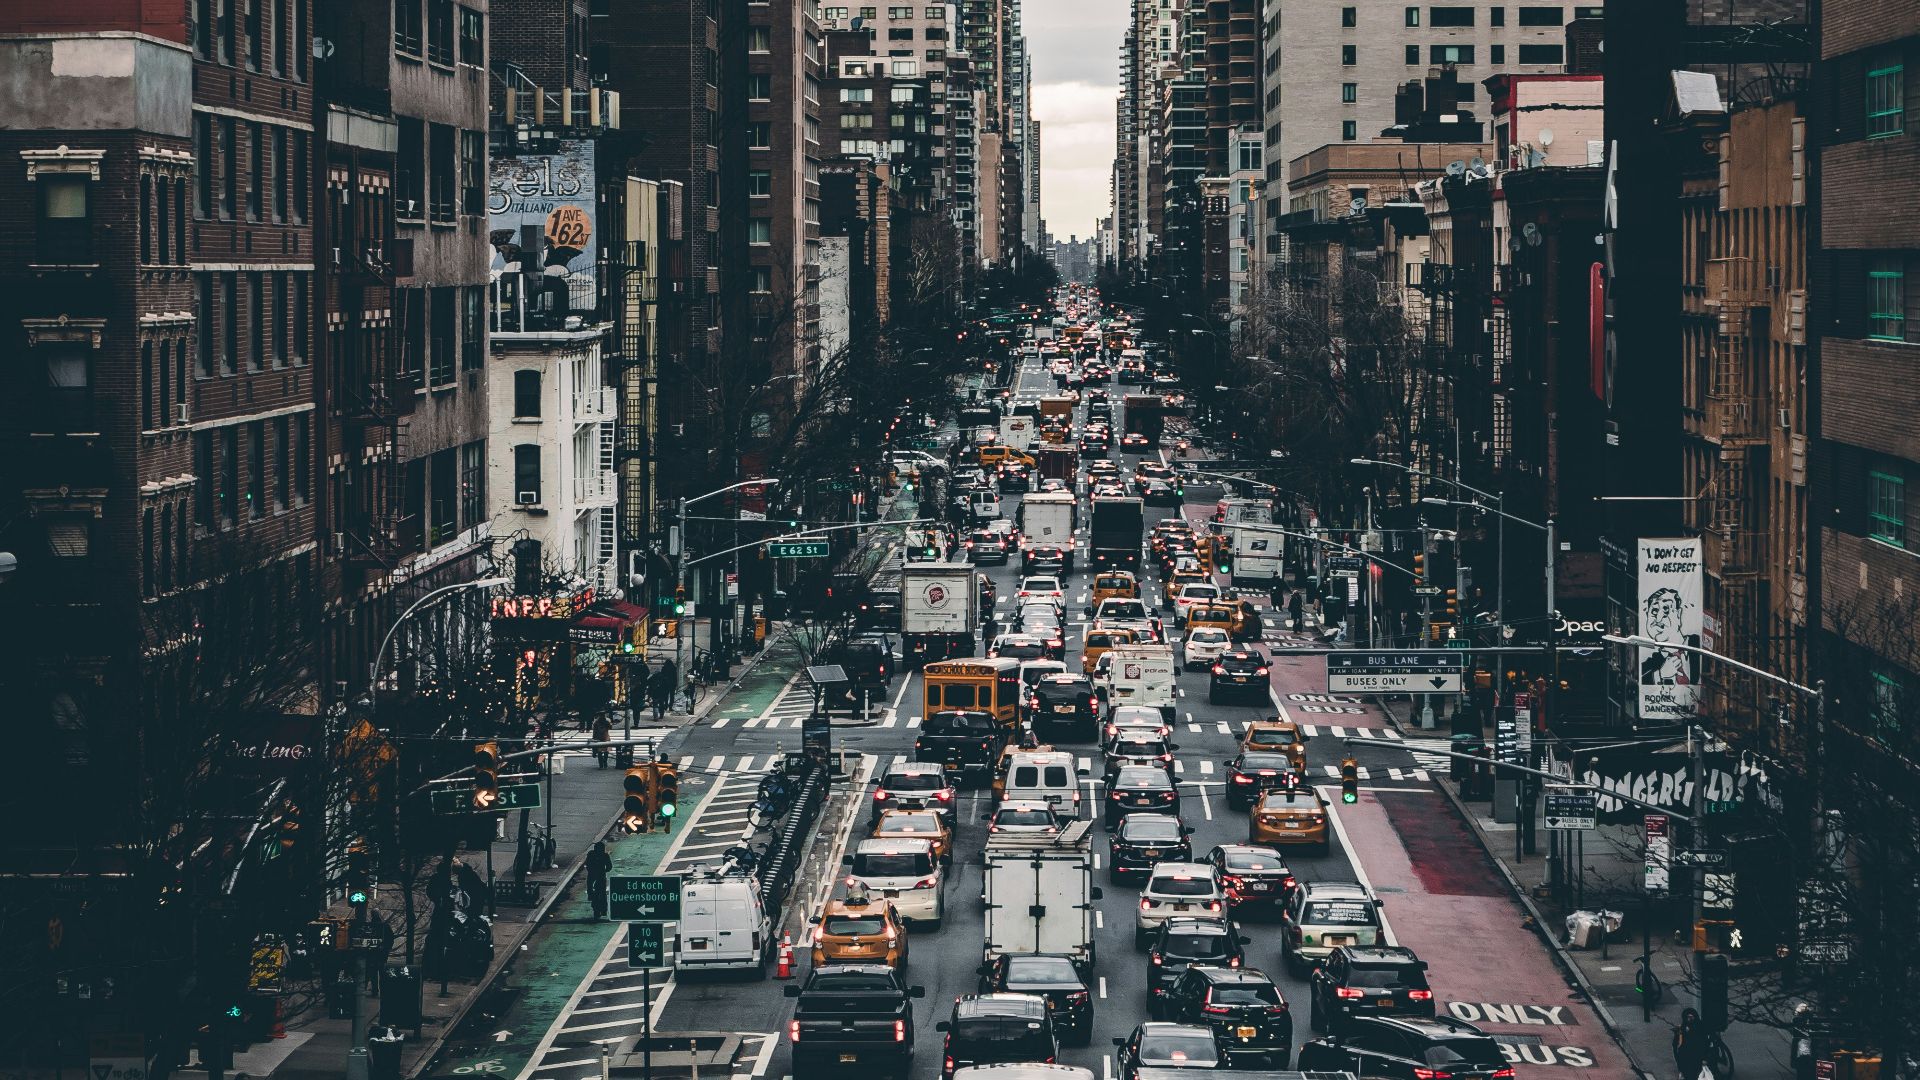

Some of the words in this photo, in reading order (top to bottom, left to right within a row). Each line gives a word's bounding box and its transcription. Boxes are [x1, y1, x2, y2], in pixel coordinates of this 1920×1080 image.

[511, 202, 554, 214] ITALIANO
[562, 209, 582, 222] AVE
[558, 222, 584, 246] 62
[580, 233, 592, 246] ST
[780, 546, 787, 555] E
[789, 546, 803, 555] 62
[806, 546, 818, 554] St
[1654, 545, 1679, 560] DON'T
[1680, 547, 1695, 559] GET
[1645, 563, 1660, 574] NO
[1368, 656, 1386, 665] BUS
[1394, 656, 1419, 665] LANE
[1346, 677, 1377, 686] BUSES
[1382, 677, 1407, 686] ONLY
[1288, 694, 1362, 703] ONLY
[1644, 694, 1676, 703] RODNEY
[1301, 705, 1364, 714] BUS
[497, 791, 517, 805] St
[627, 881, 638, 890] Ed
[641, 881, 663, 890] Koch
[611, 892, 667, 902] Queensboro
[669, 892, 679, 901] Br
[634, 939, 639, 948] 2
[643, 939, 658, 948] Ave
[1448, 1001, 1566, 1025] ONLY
[1497, 1042, 1593, 1067] BUS
